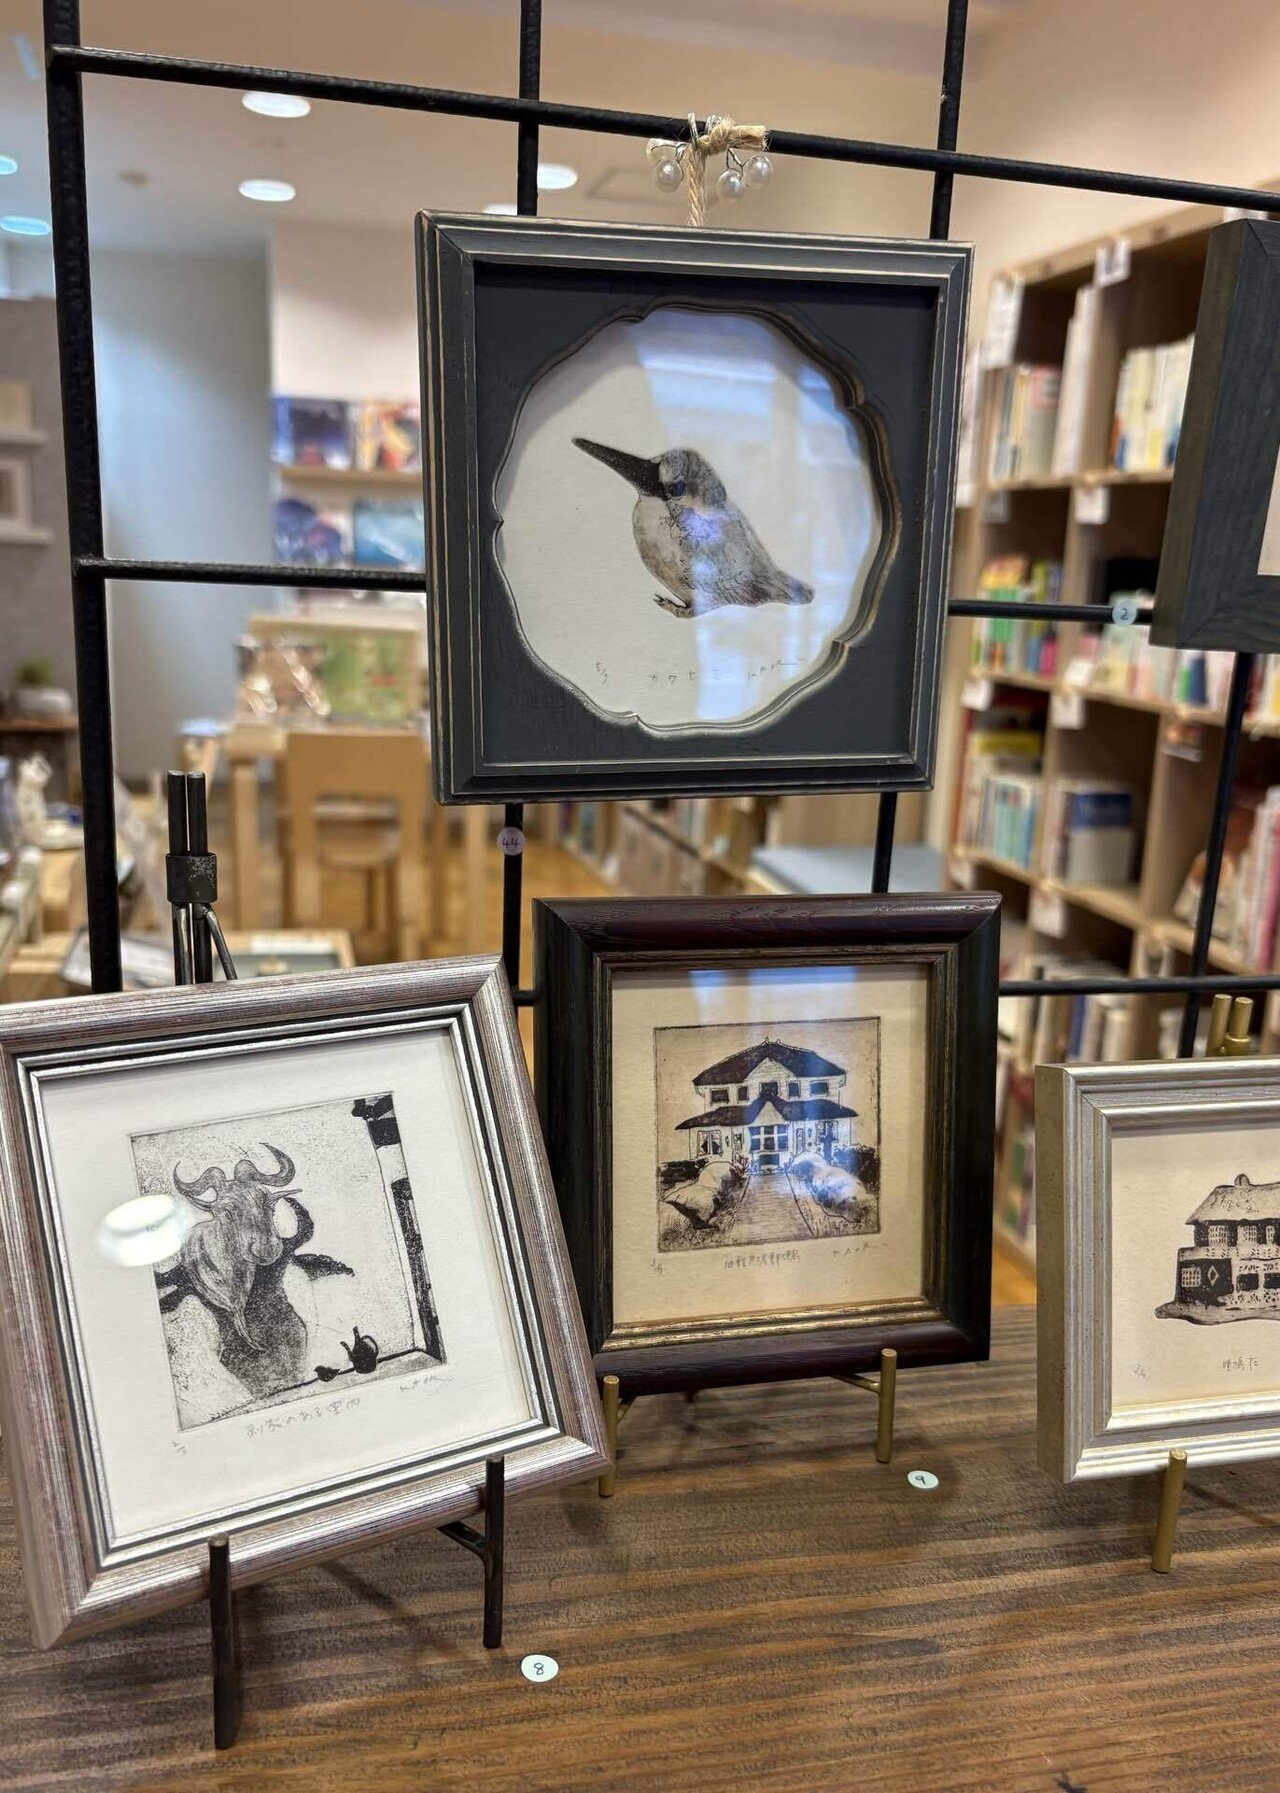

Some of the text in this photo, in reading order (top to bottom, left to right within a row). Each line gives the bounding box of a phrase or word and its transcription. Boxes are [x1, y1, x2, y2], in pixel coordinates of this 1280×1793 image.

[1119, 607, 1129, 620] 2
[915, 1475, 926, 1485] 9
[533, 1662, 545, 1676] 8
